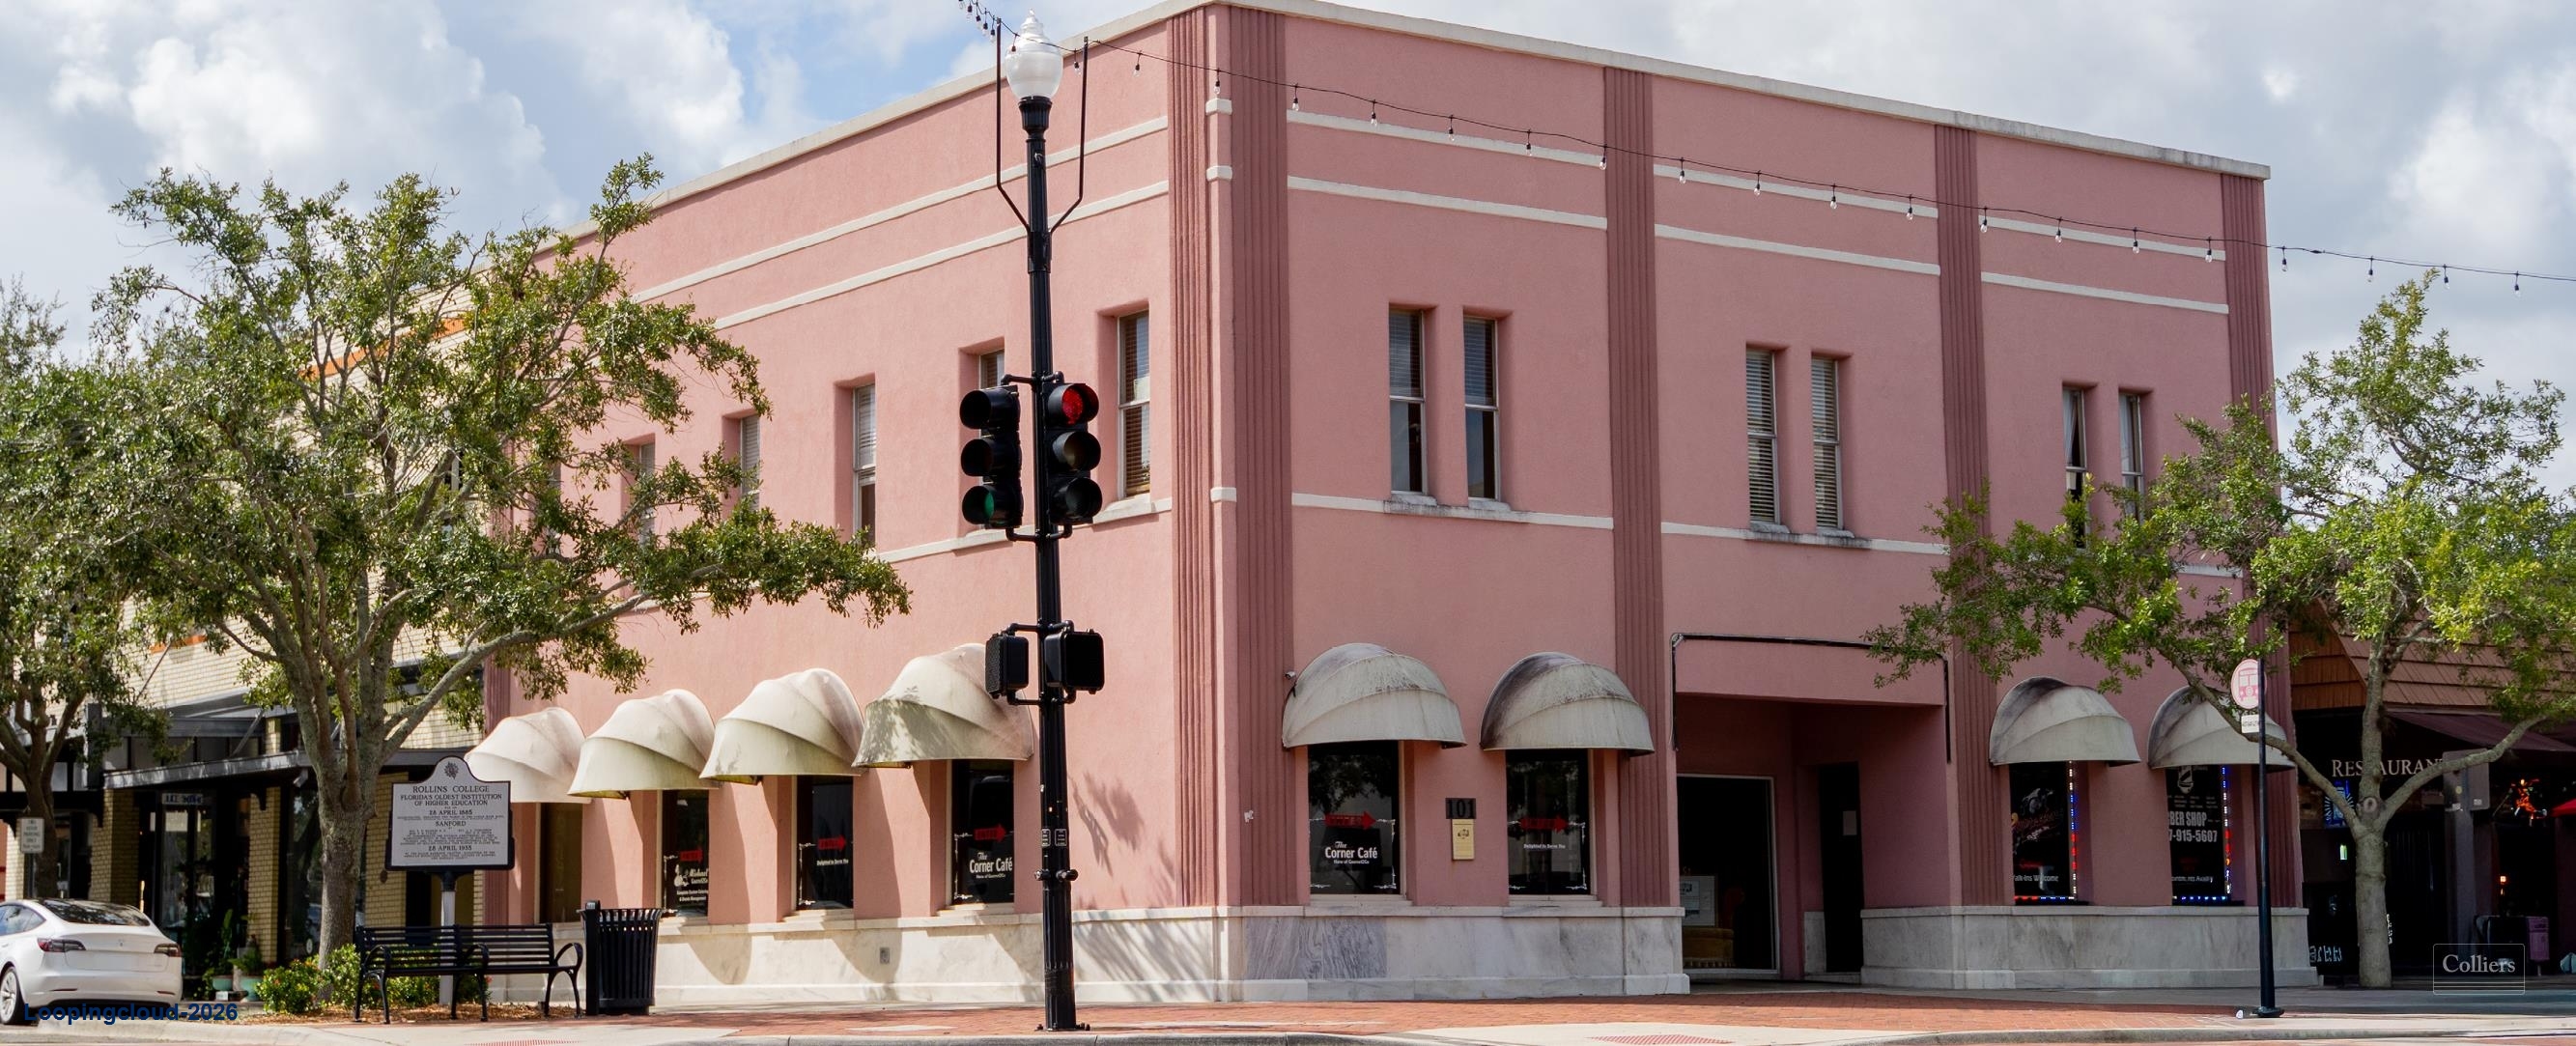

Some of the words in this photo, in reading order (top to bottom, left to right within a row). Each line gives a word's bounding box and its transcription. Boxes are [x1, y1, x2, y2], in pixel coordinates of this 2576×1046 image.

[2332, 758, 2444, 777] RESAURA
[1448, 800, 1475, 818] 101
[2186, 811, 2208, 827] SHOP
[1324, 846, 1356, 859] Corner
[1357, 846, 1378, 859] Café
[969, 859, 995, 873] Corner
[996, 857, 1013, 872] Café
